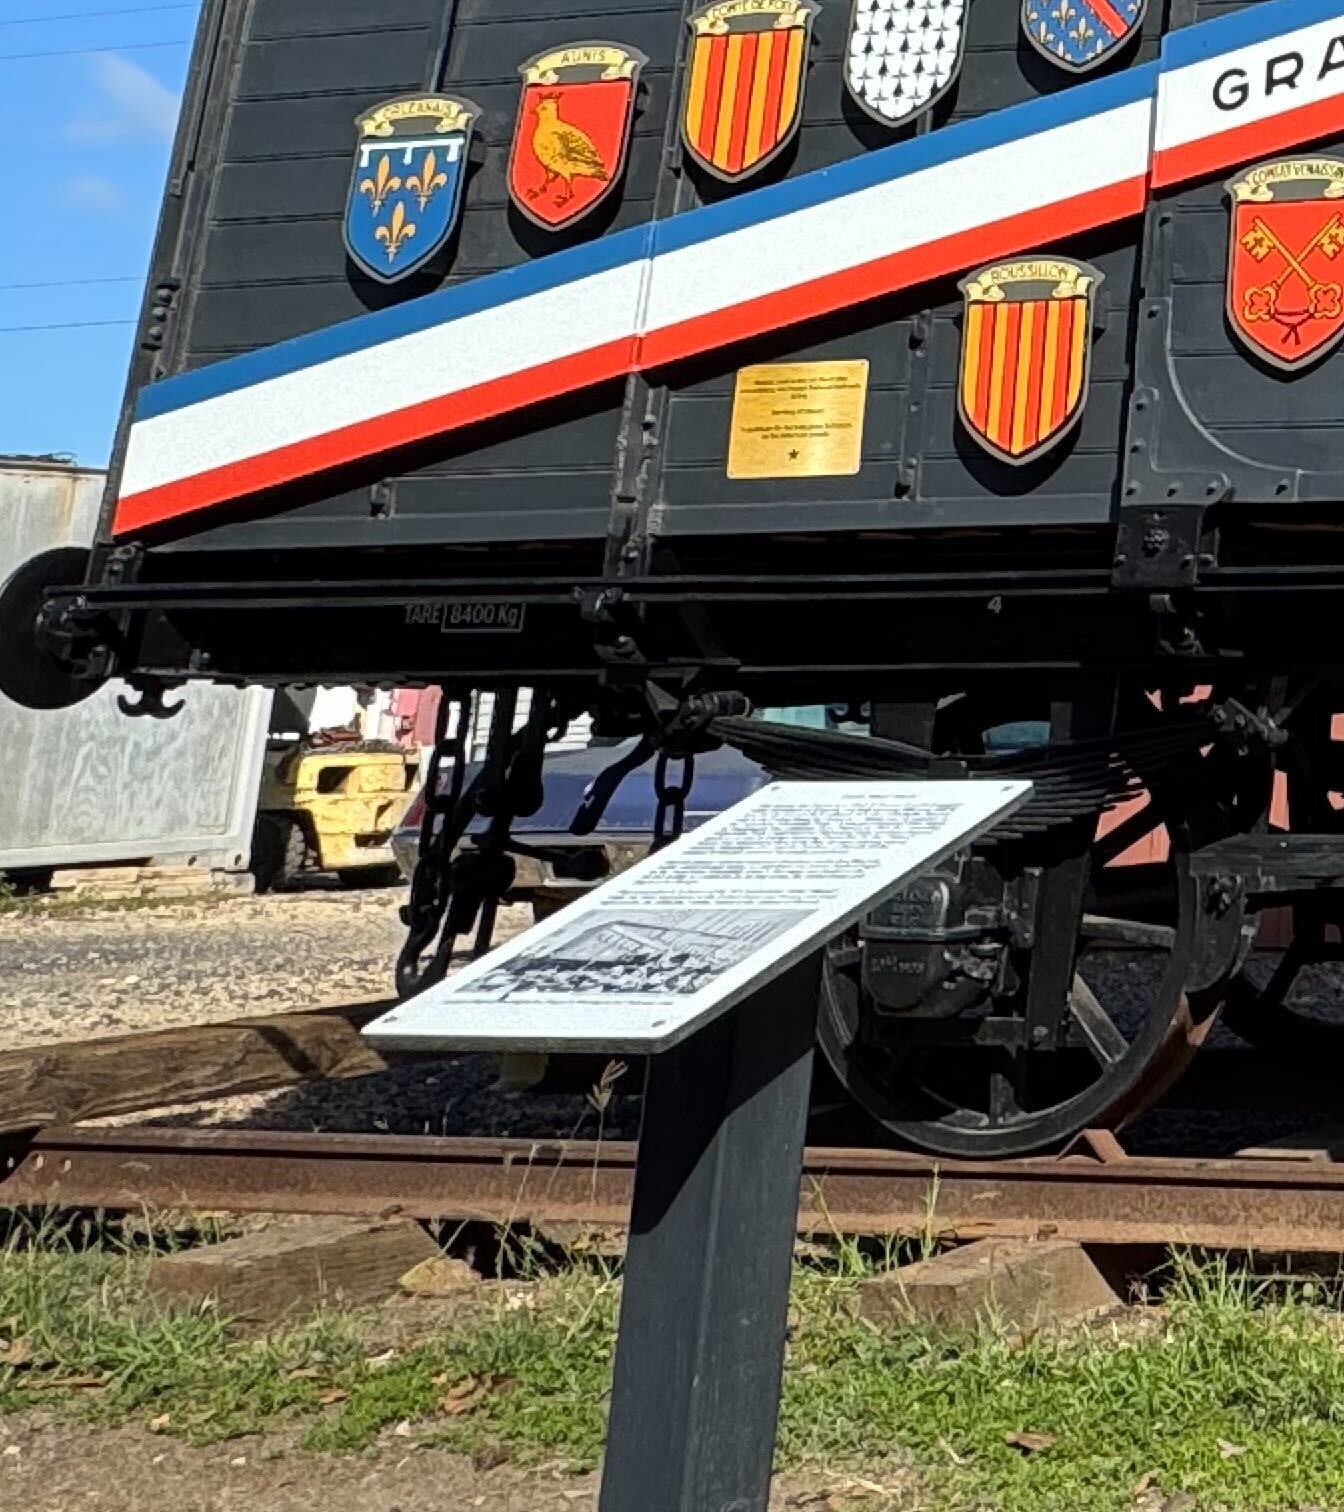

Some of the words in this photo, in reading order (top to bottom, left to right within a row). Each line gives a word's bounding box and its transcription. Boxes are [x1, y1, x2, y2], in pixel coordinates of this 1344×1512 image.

[560, 50, 606, 65] AUNIS
[404, 603, 441, 624] TARE
[450, 603, 496, 624] 8400
[987, 595, 1002, 614] 4
